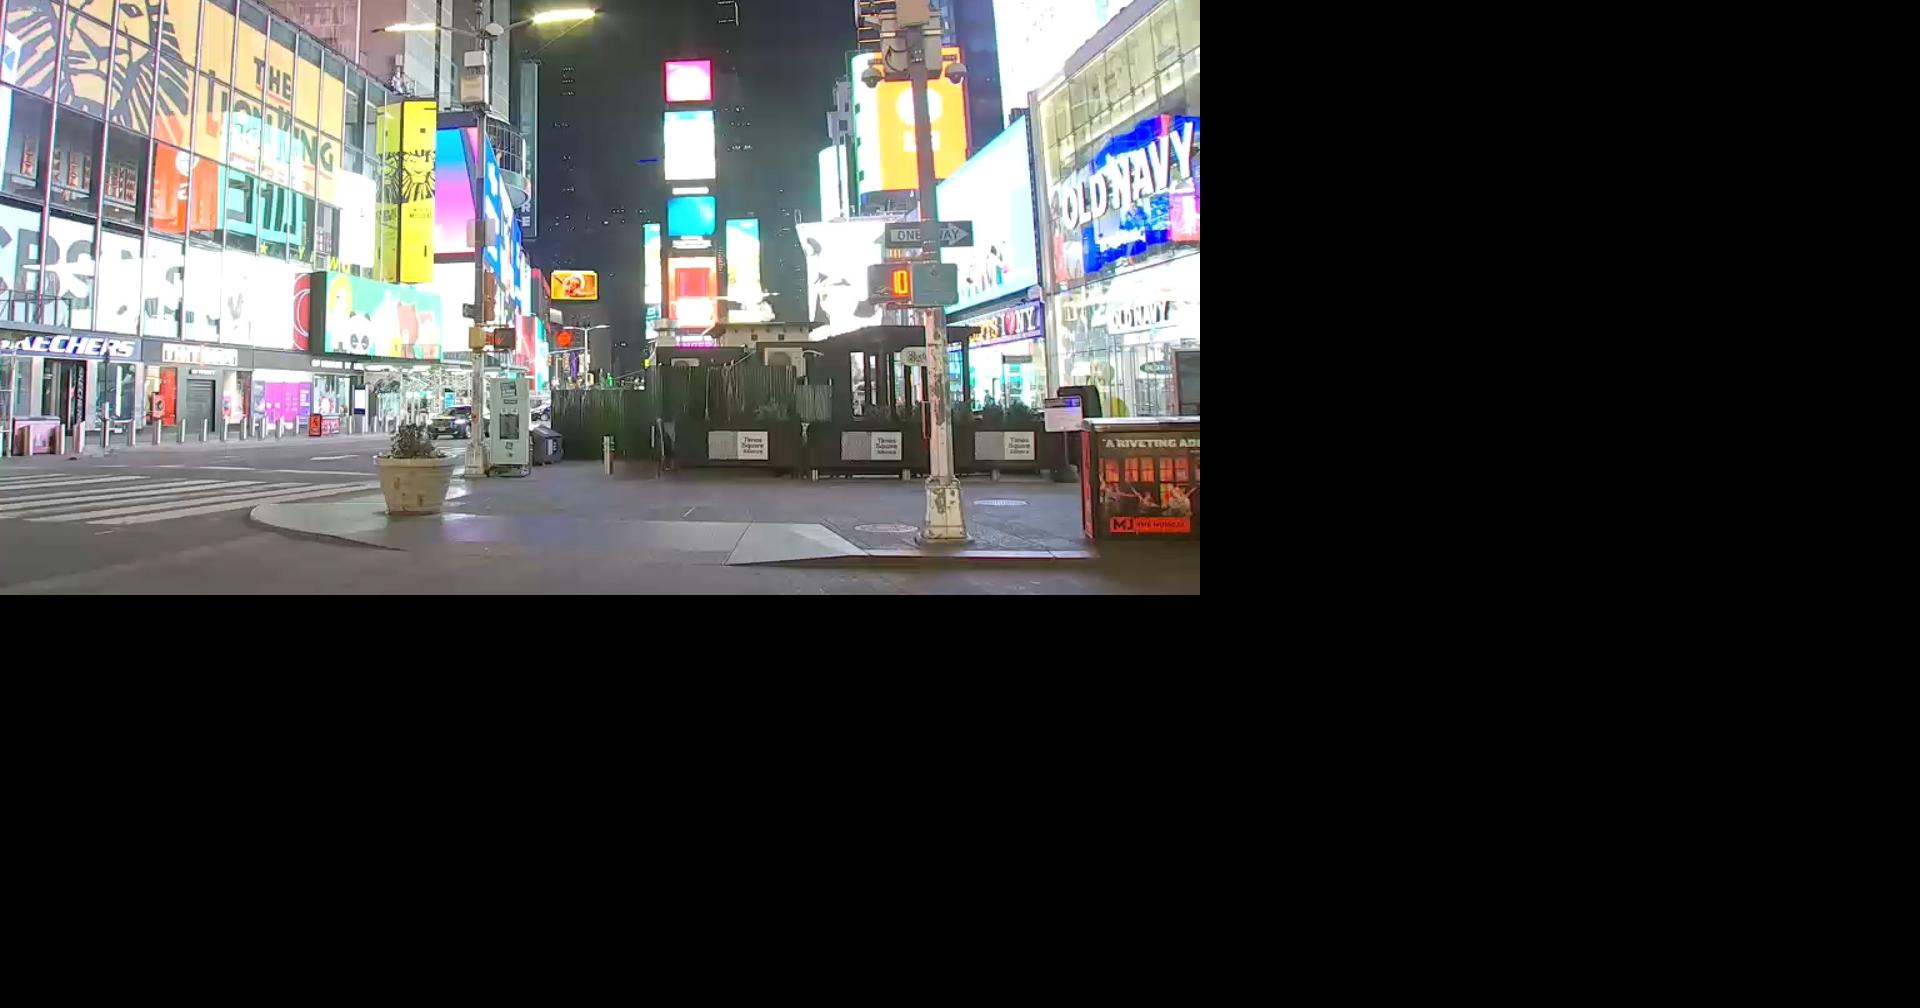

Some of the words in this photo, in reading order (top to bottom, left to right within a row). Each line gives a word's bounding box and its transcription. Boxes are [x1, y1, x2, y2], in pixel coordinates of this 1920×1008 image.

[253, 56, 292, 100] THE
[1106, 121, 1195, 211] NAVY
[897, 230, 921, 240] ONE
[1115, 440, 1177, 448] RIVETING
[1113, 518, 1135, 530] MJ
